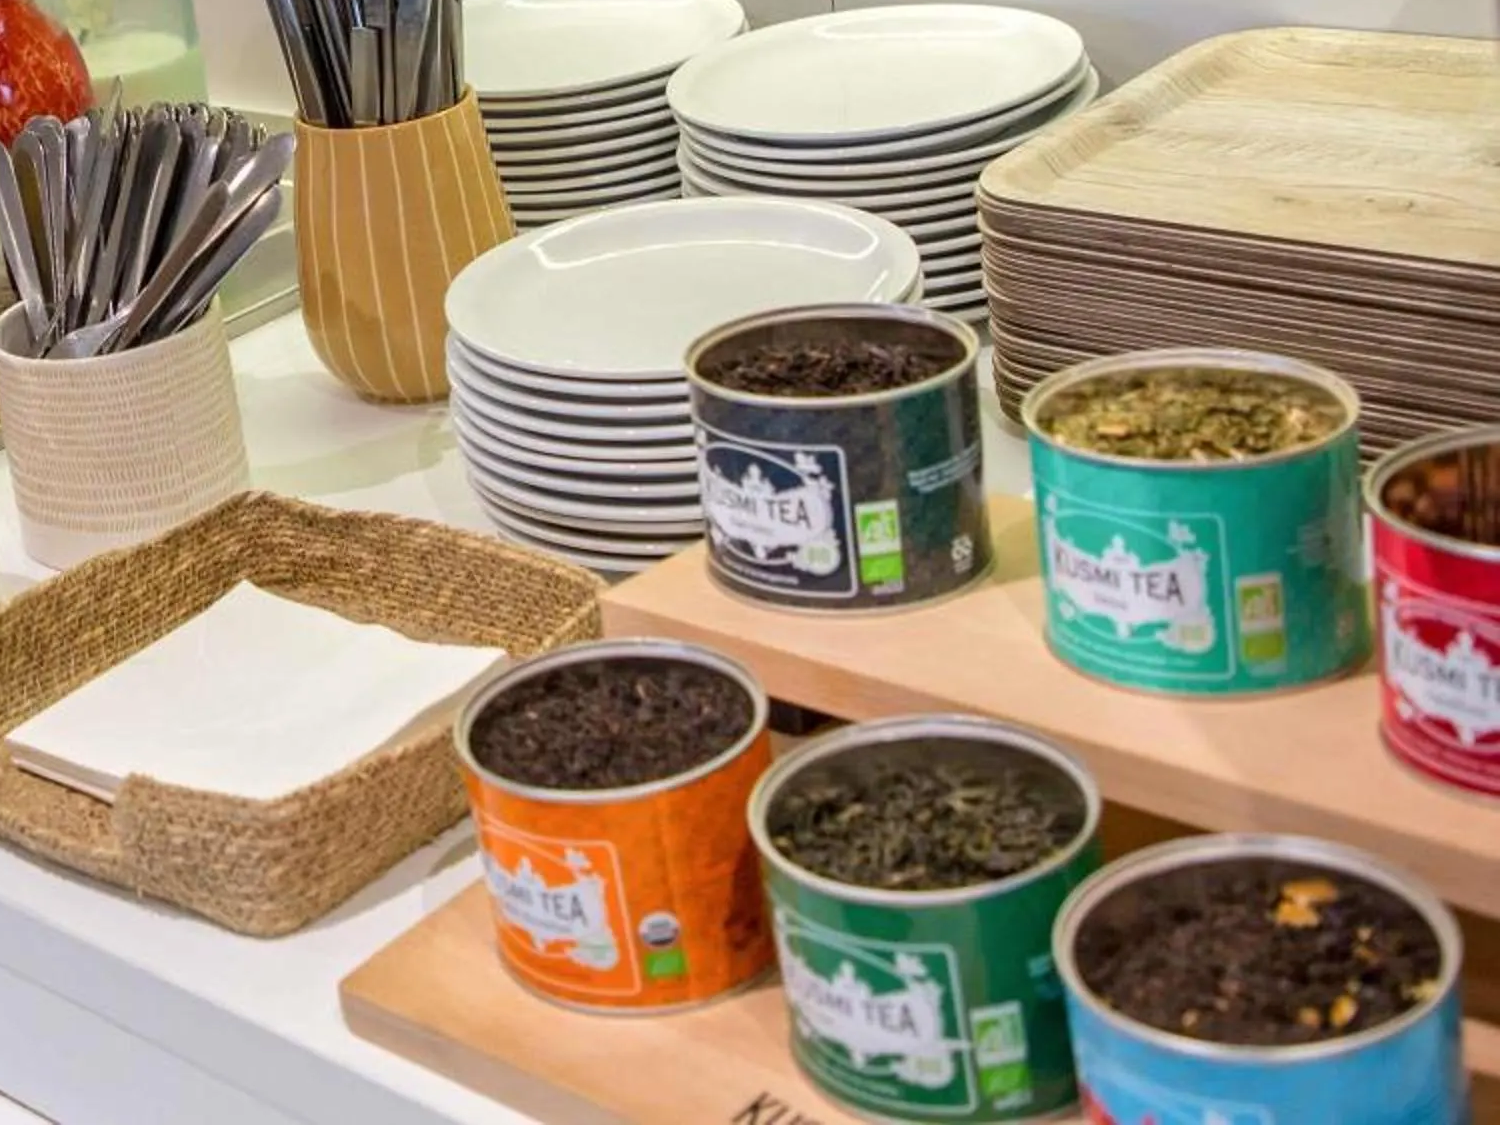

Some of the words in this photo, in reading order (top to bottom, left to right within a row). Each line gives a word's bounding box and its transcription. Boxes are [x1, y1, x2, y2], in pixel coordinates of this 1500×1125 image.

[764, 498, 812, 529] TEA
[1054, 545, 1120, 588] KUSMI
[1129, 571, 1185, 607] TEA
[540, 892, 588, 928] TEA
[861, 999, 920, 1038] TEA
